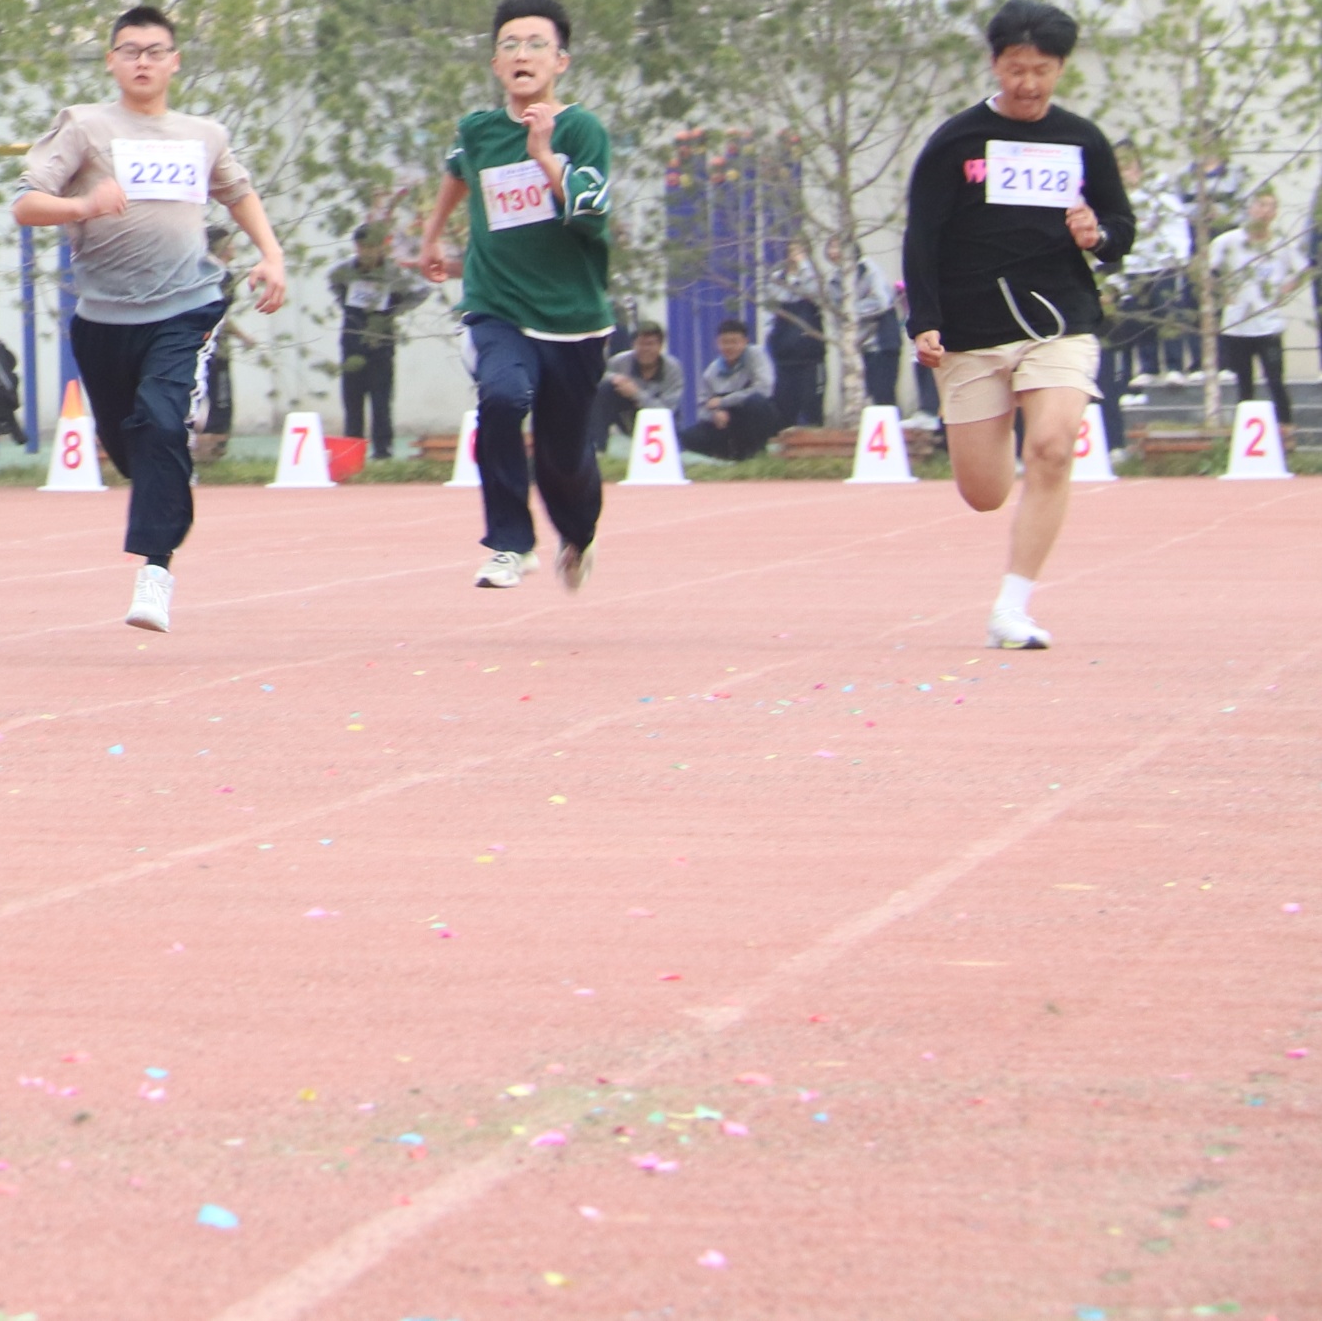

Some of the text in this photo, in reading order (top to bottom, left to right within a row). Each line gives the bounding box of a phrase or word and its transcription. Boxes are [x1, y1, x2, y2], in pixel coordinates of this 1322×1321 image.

[130, 162, 197, 186] 2223
[1001, 167, 1070, 192] 2128
[62, 430, 82, 470] 8
[290, 427, 310, 465] 7
[644, 425, 665, 464] 5
[867, 420, 889, 460] 4
[1244, 418, 1266, 457] 2
